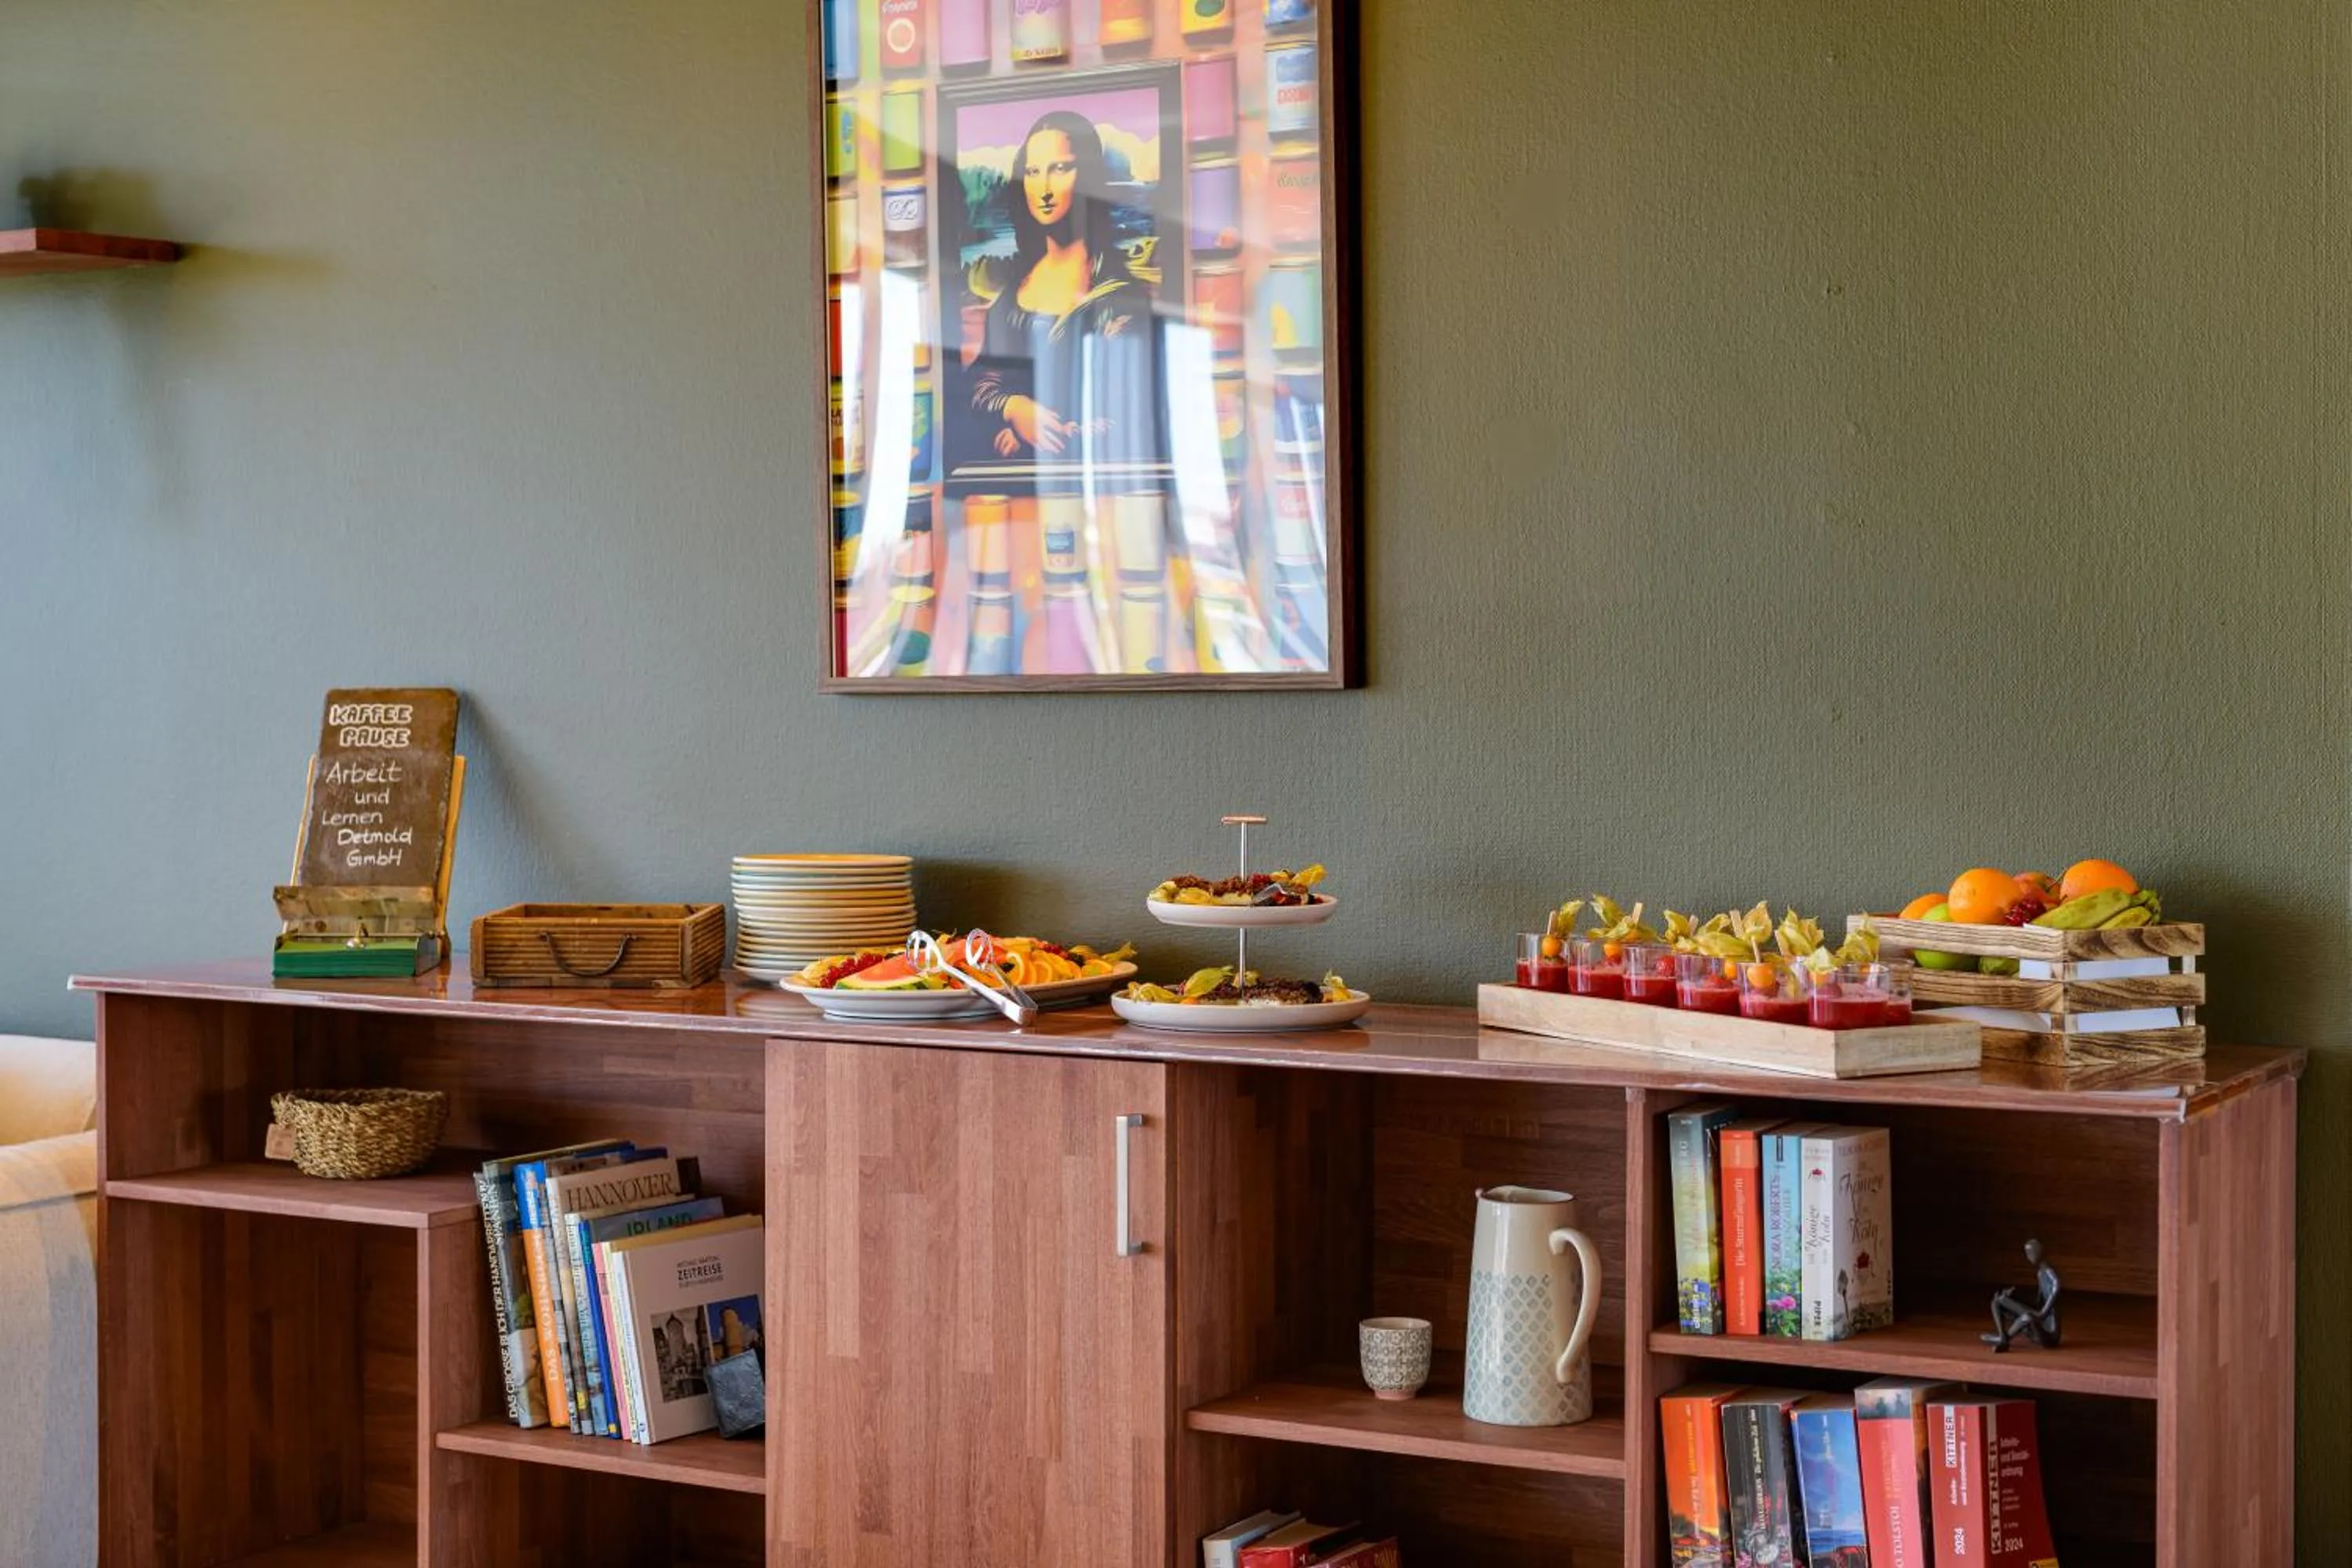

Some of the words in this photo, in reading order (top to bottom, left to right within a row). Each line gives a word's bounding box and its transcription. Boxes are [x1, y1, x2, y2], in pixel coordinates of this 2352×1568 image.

[329, 703, 413, 725] KAFFEE
[340, 726, 410, 748] PAUSE
[326, 761, 402, 784] Arbeit
[354, 788, 390, 804] und
[321, 811, 383, 826] Lernen
[337, 827, 412, 847] Detmold
[347, 848, 402, 866] GmbH
[566, 1173, 676, 1212] HANNOVER
[485, 1183, 503, 1244] SPANIEN
[677, 1262, 723, 1281] ZEITREISE
[493, 1287, 505, 1311] DER
[496, 1312, 509, 1346] BUCH
[501, 1347, 515, 1393] GROSSE
[546, 1348, 559, 1381] DAS
[508, 1395, 518, 1418] DAS
[1945, 1416, 1956, 1466] KITTNER
[1989, 1441, 2001, 1551] KITTNER
[1955, 1527, 1965, 1555] 2024
[2004, 1537, 2024, 1552] 2024
